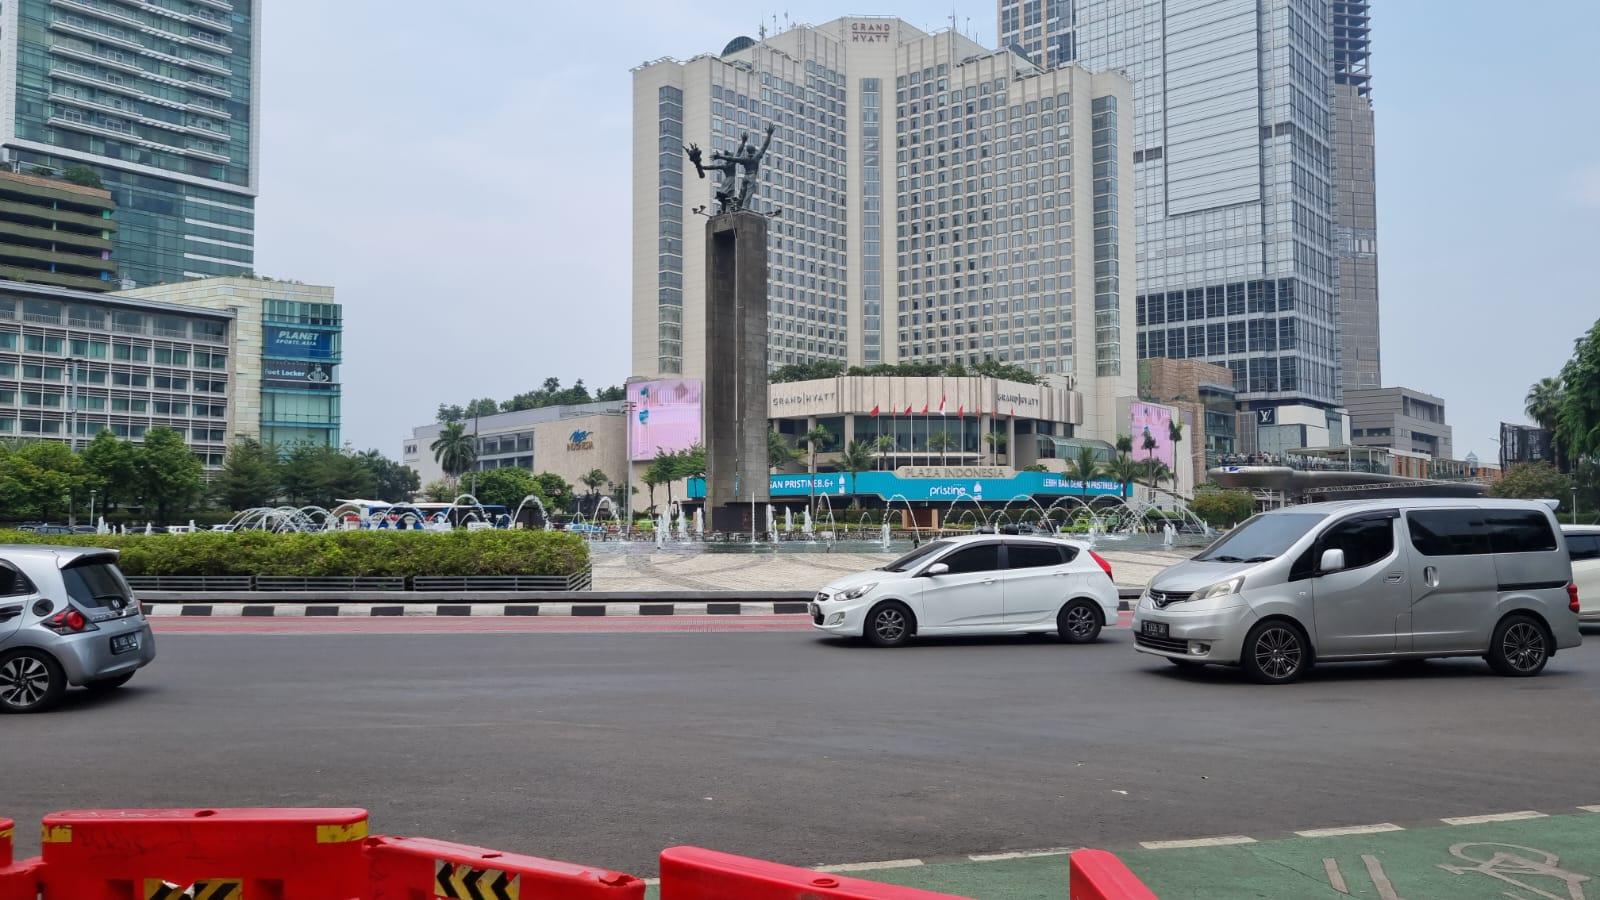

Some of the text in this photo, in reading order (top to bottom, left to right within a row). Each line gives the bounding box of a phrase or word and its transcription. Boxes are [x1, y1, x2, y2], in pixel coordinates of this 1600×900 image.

[852, 23, 889, 31] GRAND
[852, 34, 889, 43] HYATT
[278, 330, 319, 341] PLANET
[281, 369, 305, 377] Locker
[904, 468, 1006, 478] PLAZA INDONESIA
[929, 484, 966, 496] pristine
